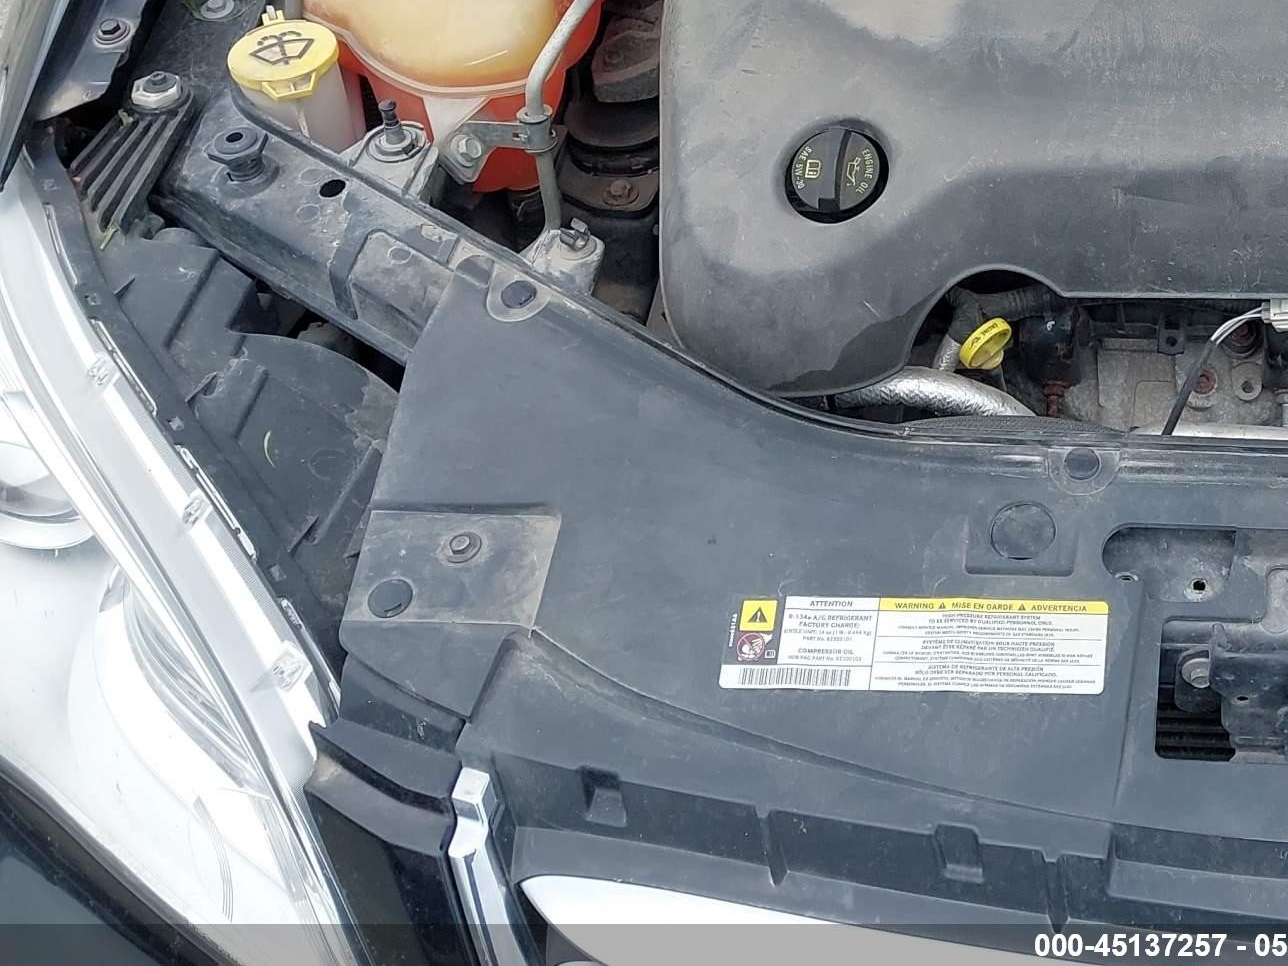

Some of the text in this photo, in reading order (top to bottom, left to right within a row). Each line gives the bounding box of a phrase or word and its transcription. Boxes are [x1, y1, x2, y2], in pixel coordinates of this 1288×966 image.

[798, 146, 813, 161] SAE
[855, 148, 874, 194] ENGINE OIL
